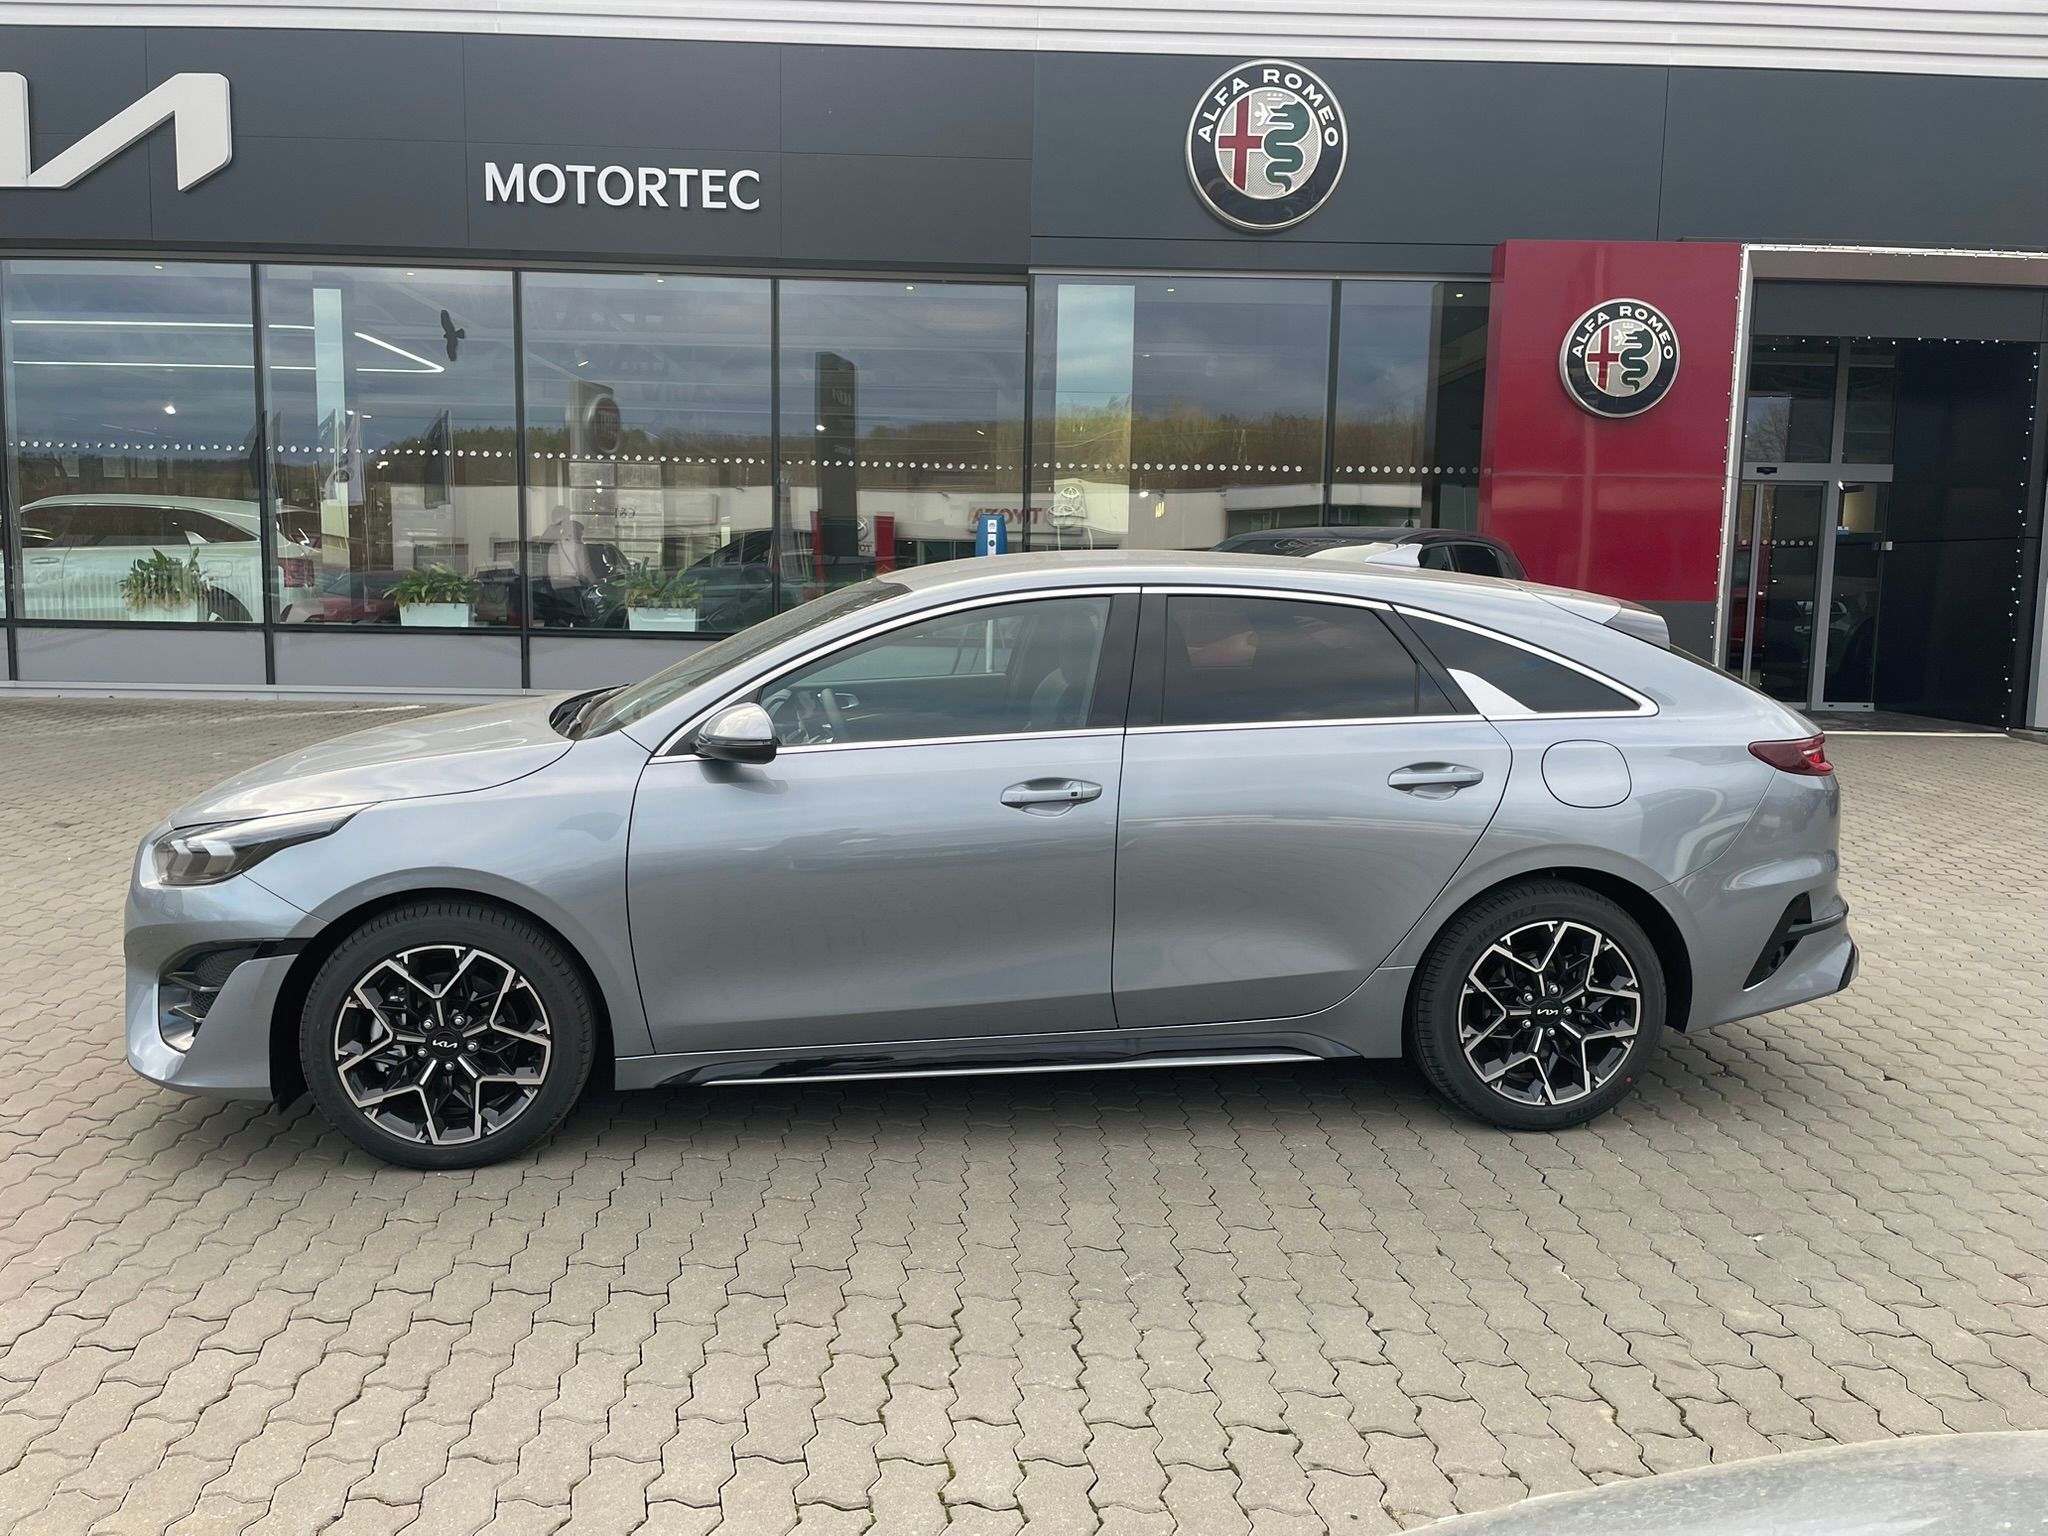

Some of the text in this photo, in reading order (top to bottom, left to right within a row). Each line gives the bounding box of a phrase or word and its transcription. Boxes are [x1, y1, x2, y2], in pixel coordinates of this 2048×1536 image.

[1198, 68, 1339, 147] ALFA ROMEO
[484, 162, 760, 211] MOTORTEC
[1572, 305, 1674, 360] ALFA ROMEO
[432, 1039, 458, 1049] KIA
